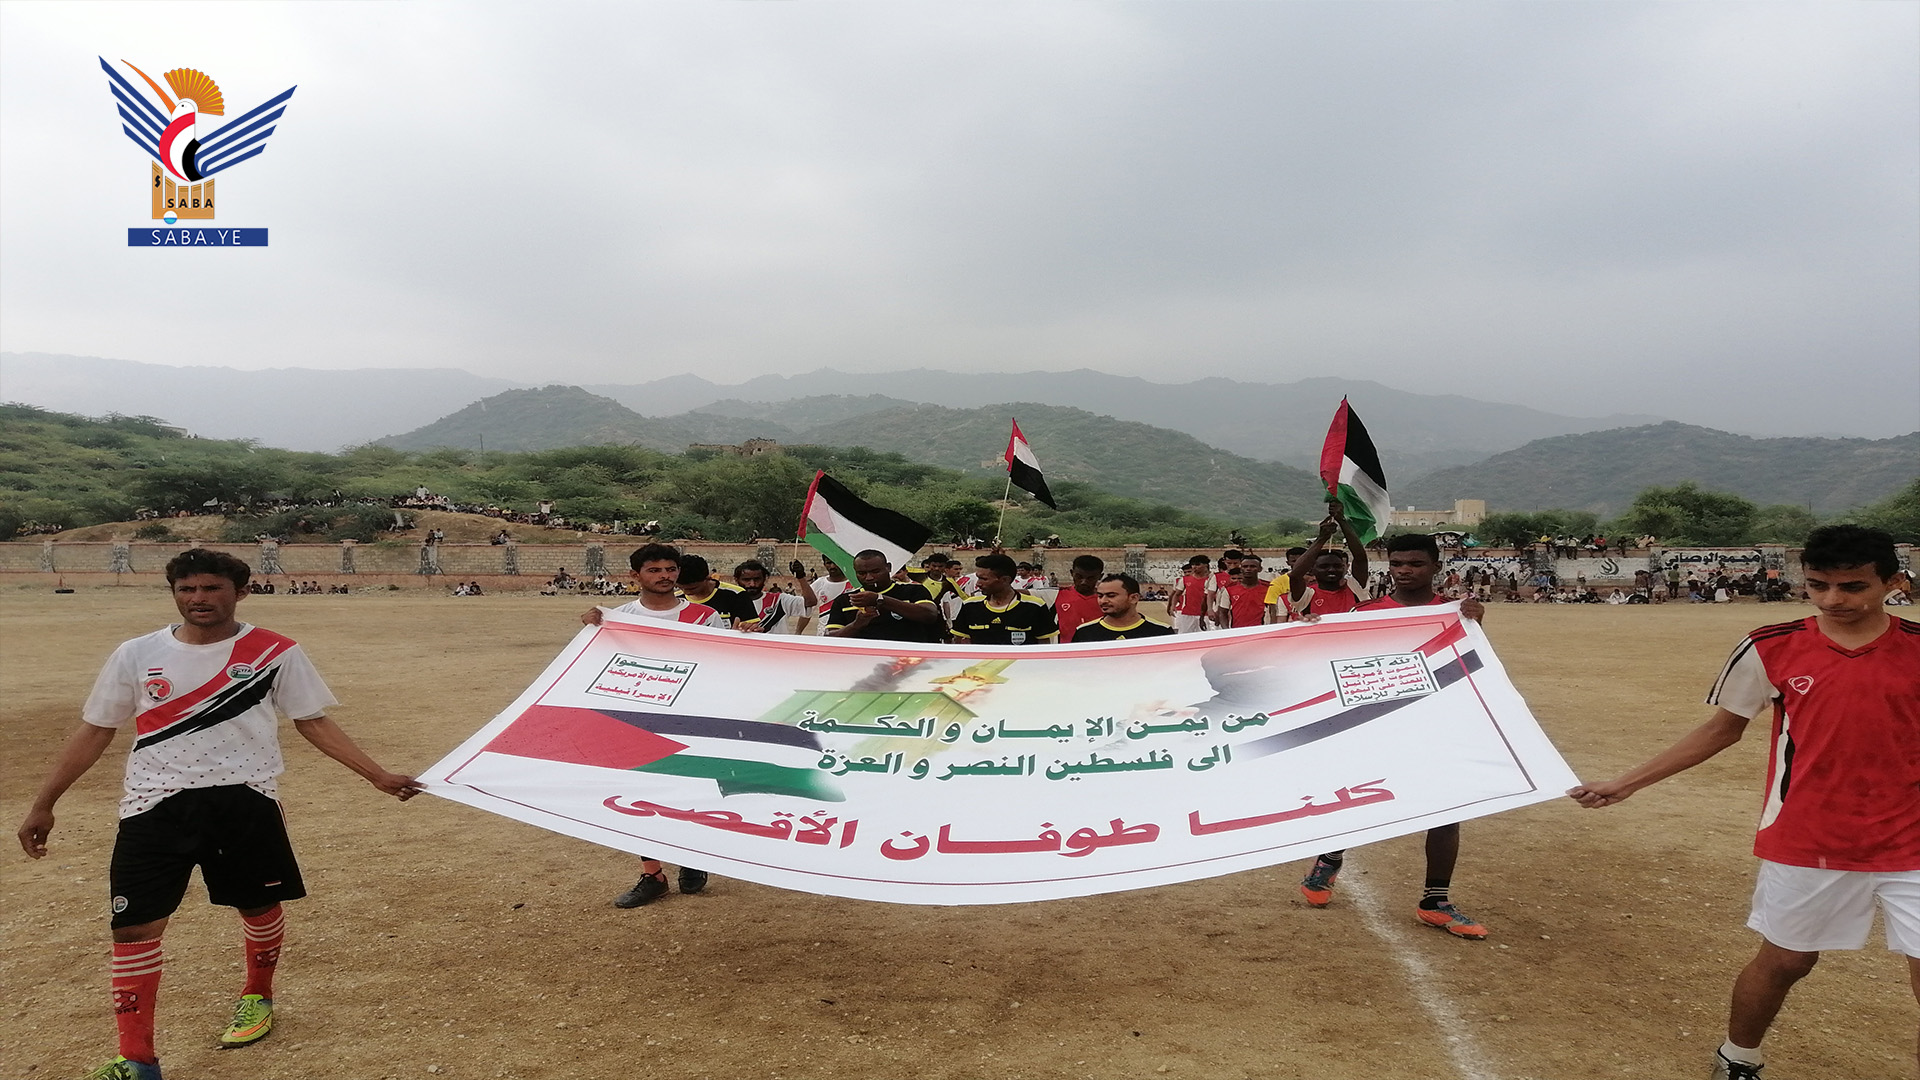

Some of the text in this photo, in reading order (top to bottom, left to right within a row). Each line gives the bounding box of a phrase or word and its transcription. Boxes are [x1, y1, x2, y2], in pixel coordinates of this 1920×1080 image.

[615, 657, 690, 674] قاطعوا
[1386, 662, 1421, 674] الموت
[1388, 655, 1419, 666] الله
[646, 674, 682, 684] البضائع
[1388, 669, 1424, 680] الموت
[1344, 676, 1428, 696] اللعنة على اليهود
[1395, 683, 1431, 696] النصر
[799, 711, 936, 739] الحكمة
[941, 721, 961, 743] و
[1126, 715, 1209, 740] يمن
[1221, 711, 1270, 734] من
[817, 743, 1232, 781] الى فلسطين النصر و العزة
[603, 777, 1396, 861] كلنا طوفان الأقصى
